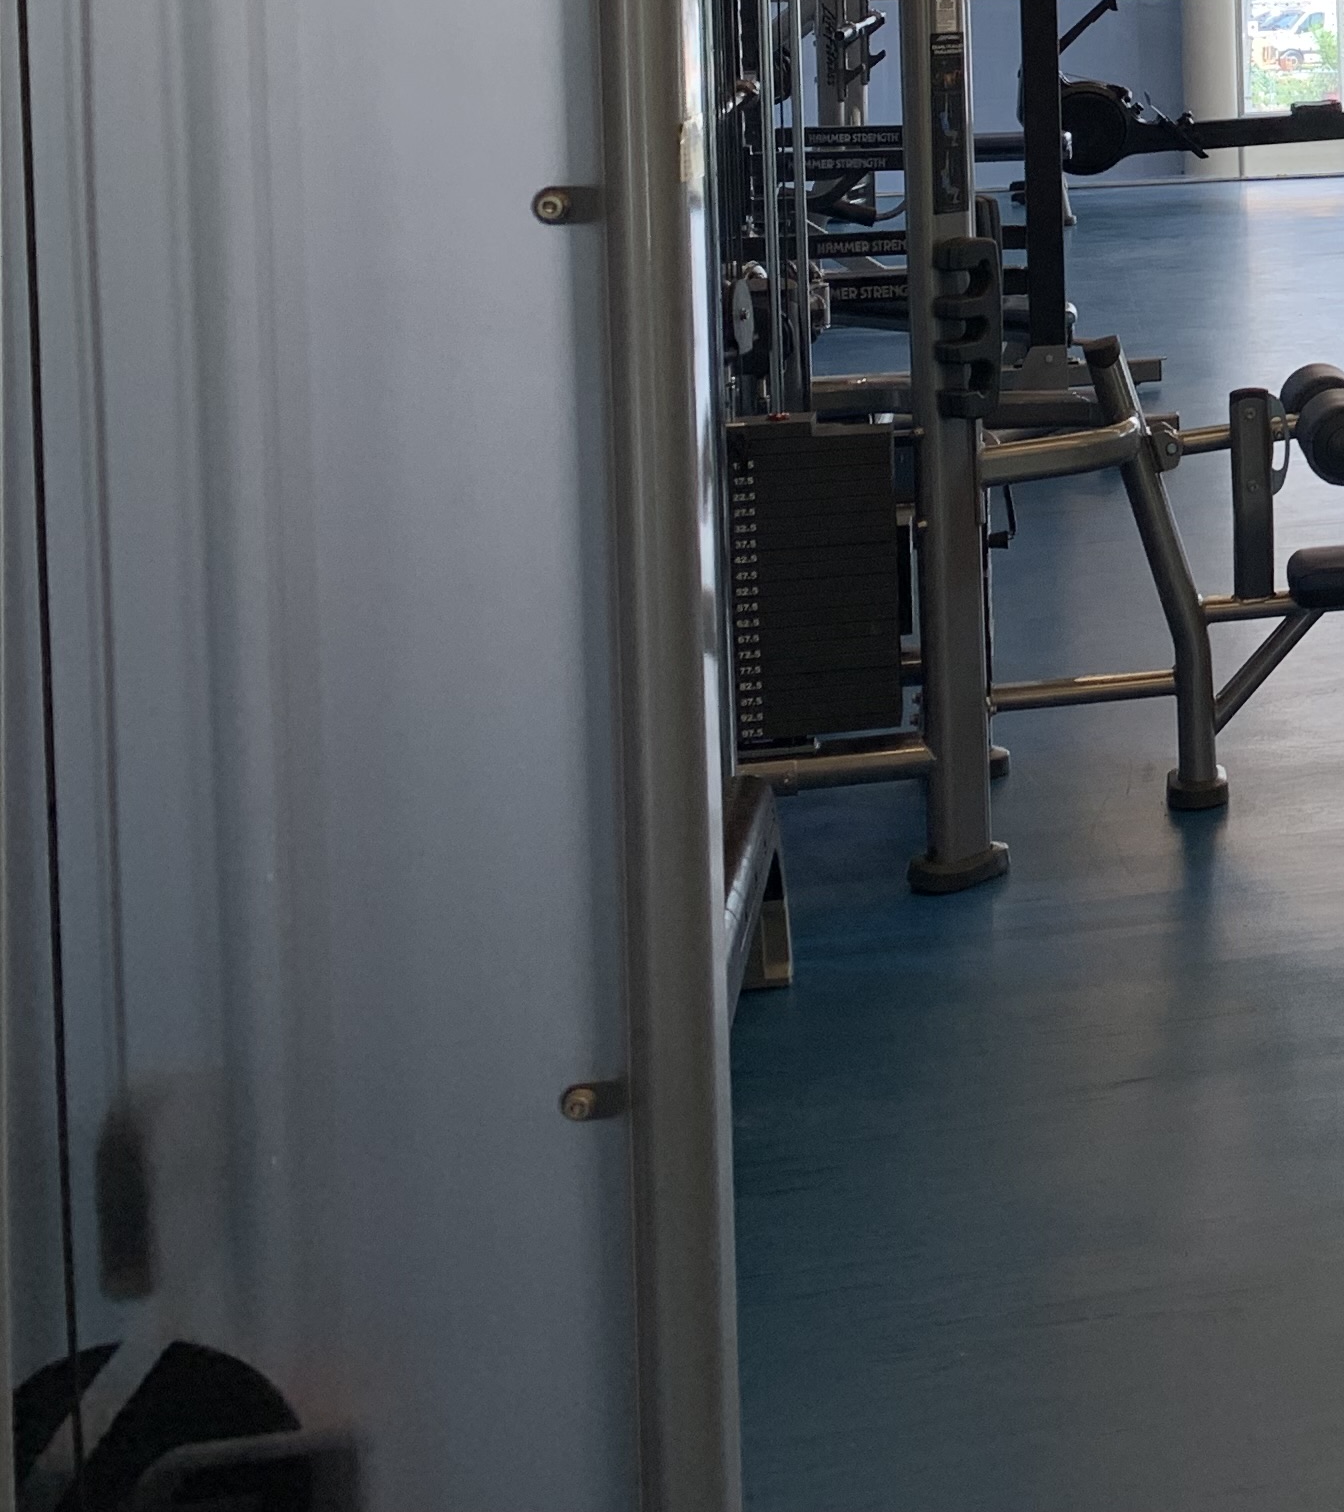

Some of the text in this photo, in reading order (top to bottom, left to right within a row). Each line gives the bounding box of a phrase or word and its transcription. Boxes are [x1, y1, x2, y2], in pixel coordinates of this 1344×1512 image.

[809, 133, 900, 143] HAMMER STRENGTH
[788, 158, 886, 169] HMMER STRENGTH
[816, 240, 869, 255] HAMMER
[734, 477, 754, 486] 17.5
[733, 493, 756, 502] 22.5
[734, 508, 756, 517] 27.5
[736, 571, 758, 580] 47.5
[738, 650, 761, 659] 72.5
[740, 666, 761, 675] 77.5
[740, 713, 763, 722] 92.5
[742, 728, 764, 738] 97.5
